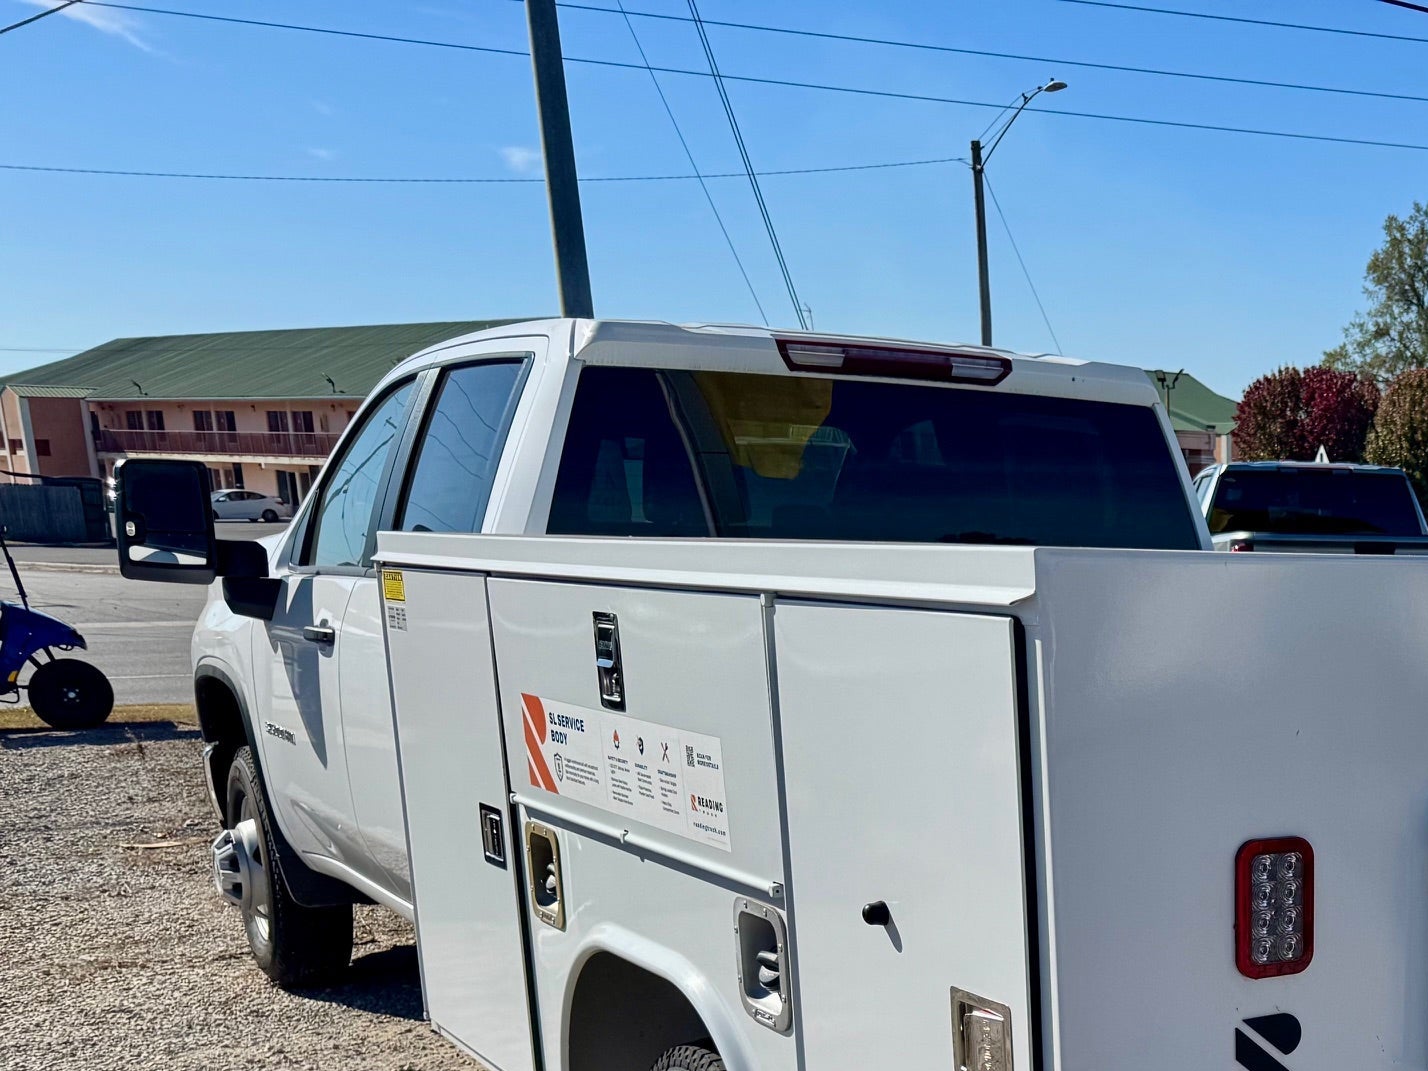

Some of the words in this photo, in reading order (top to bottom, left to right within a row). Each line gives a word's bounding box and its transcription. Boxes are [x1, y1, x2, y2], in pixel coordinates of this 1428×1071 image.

[549, 712, 558, 726] SL
[558, 714, 585, 732] SERVICE
[551, 729, 568, 745] BODY
[697, 795, 723, 813] READING
